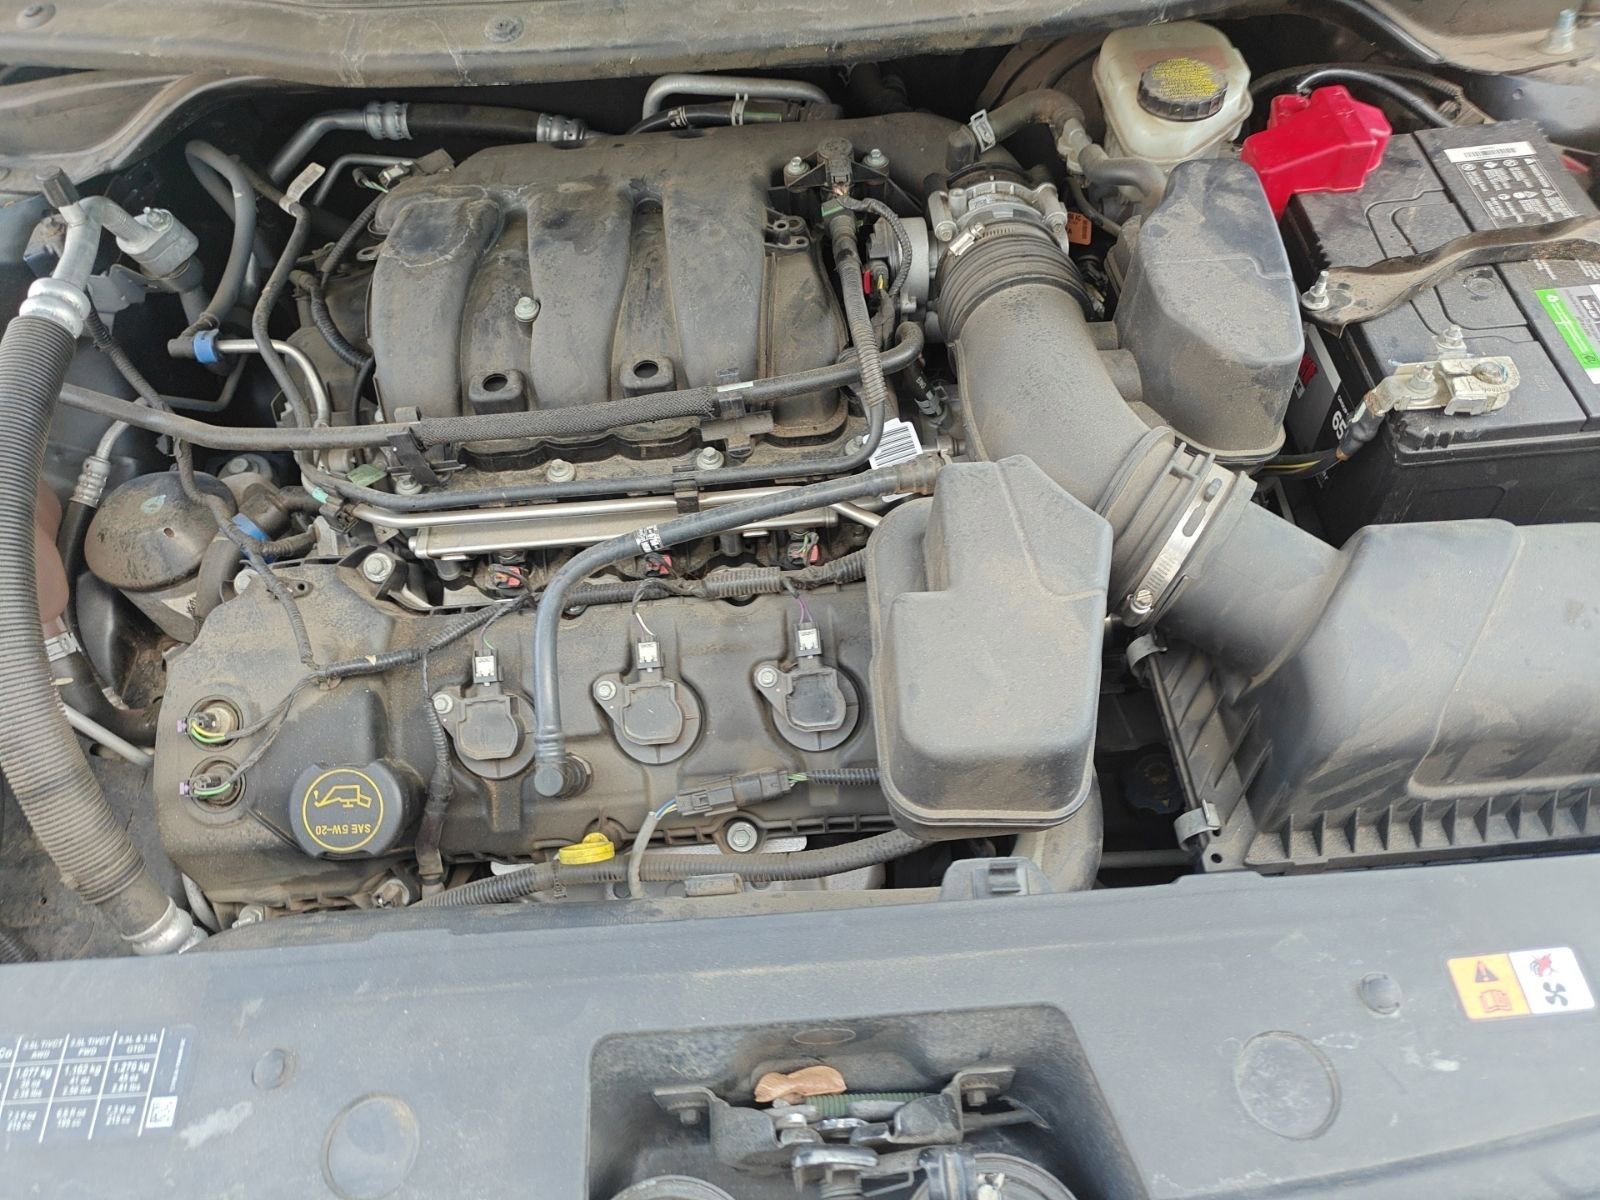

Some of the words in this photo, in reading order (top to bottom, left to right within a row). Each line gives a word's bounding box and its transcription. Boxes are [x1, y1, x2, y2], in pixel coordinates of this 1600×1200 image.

[1332, 411, 1347, 440] 65
[316, 824, 349, 836] 5W-20
[352, 824, 371, 834] SAE
[78, 1048, 97, 1057] FWD
[41, 1067, 52, 1080] kg
[90, 1064, 101, 1077] kg
[139, 1061, 150, 1074] kg
